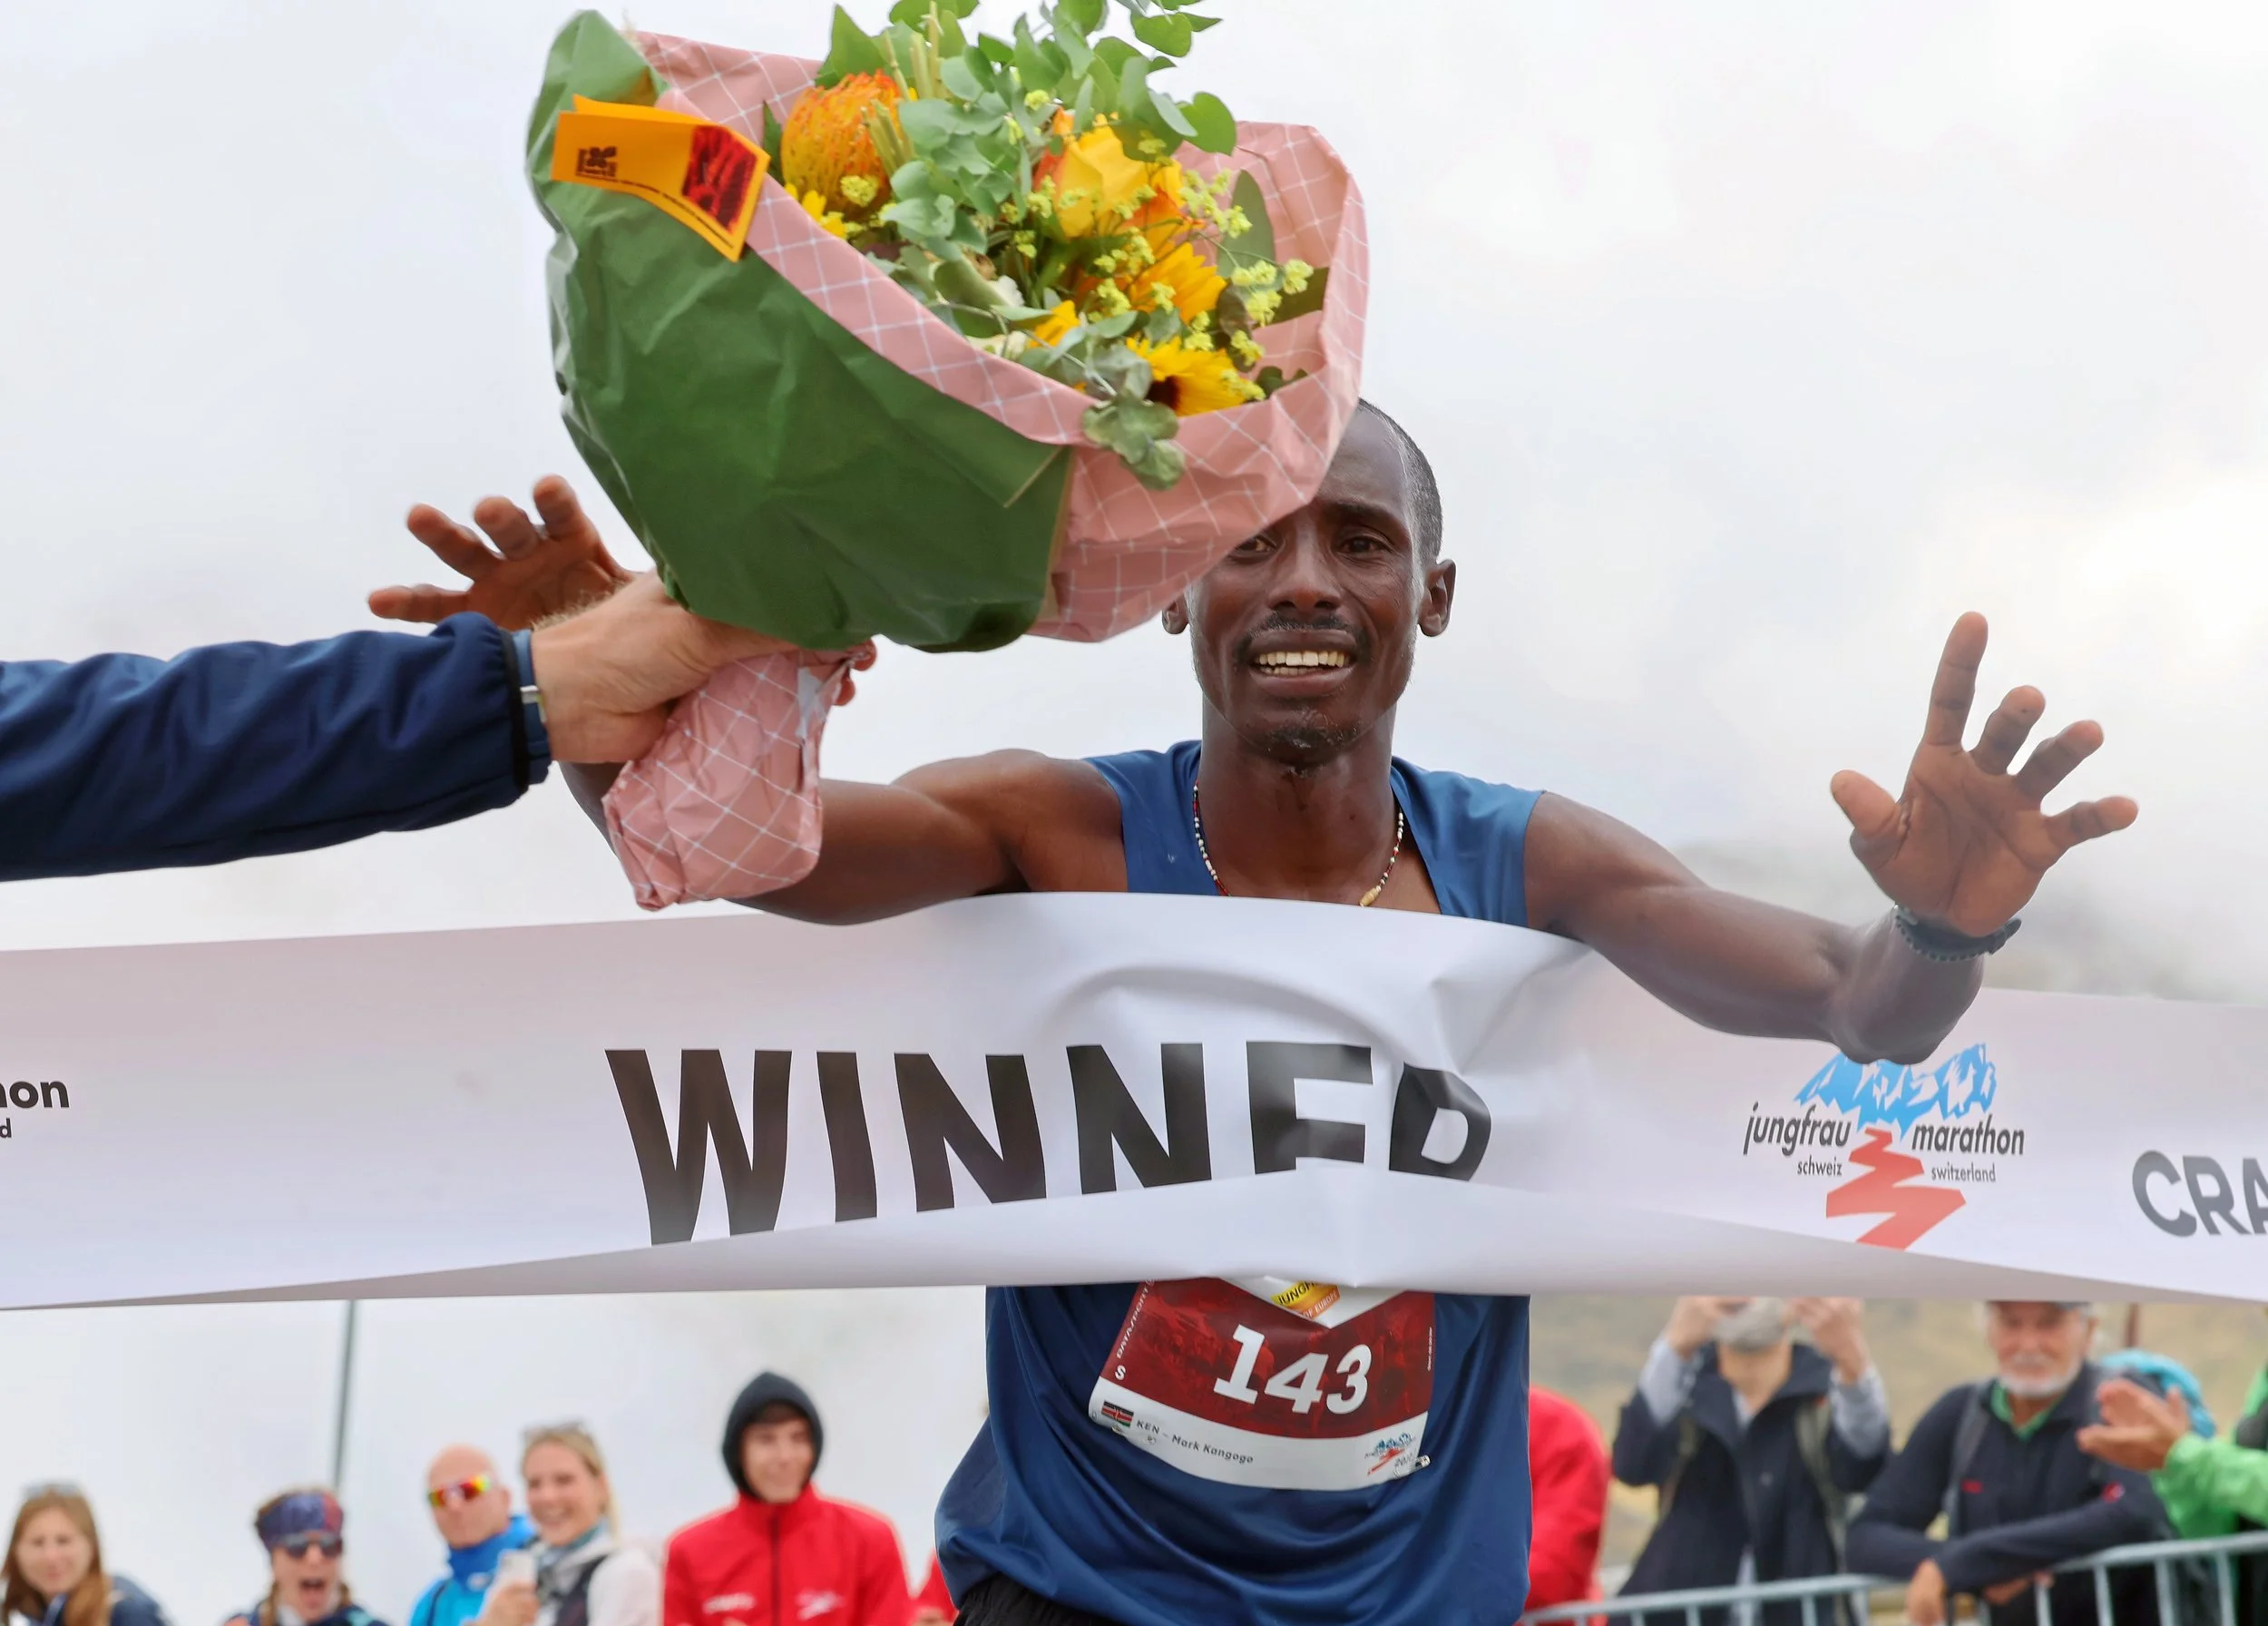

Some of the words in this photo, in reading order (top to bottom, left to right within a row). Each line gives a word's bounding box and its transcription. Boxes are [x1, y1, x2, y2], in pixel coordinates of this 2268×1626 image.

[0, 1080, 70, 1109] on
[605, 1040, 1491, 1247] WINNER
[1743, 1101, 1853, 1157] jungfrau
[1911, 1113, 2026, 1156] marathon
[1796, 1154, 1843, 1177] schweiz
[1931, 1163, 1997, 1183] switzerland
[1114, 1365, 1127, 1381] S
[1213, 1324, 1373, 1415] 143
[1136, 1419, 1160, 1435] KEN
[1171, 1434, 1200, 1452] Mark
[1203, 1444, 1254, 1464] Kangogo
